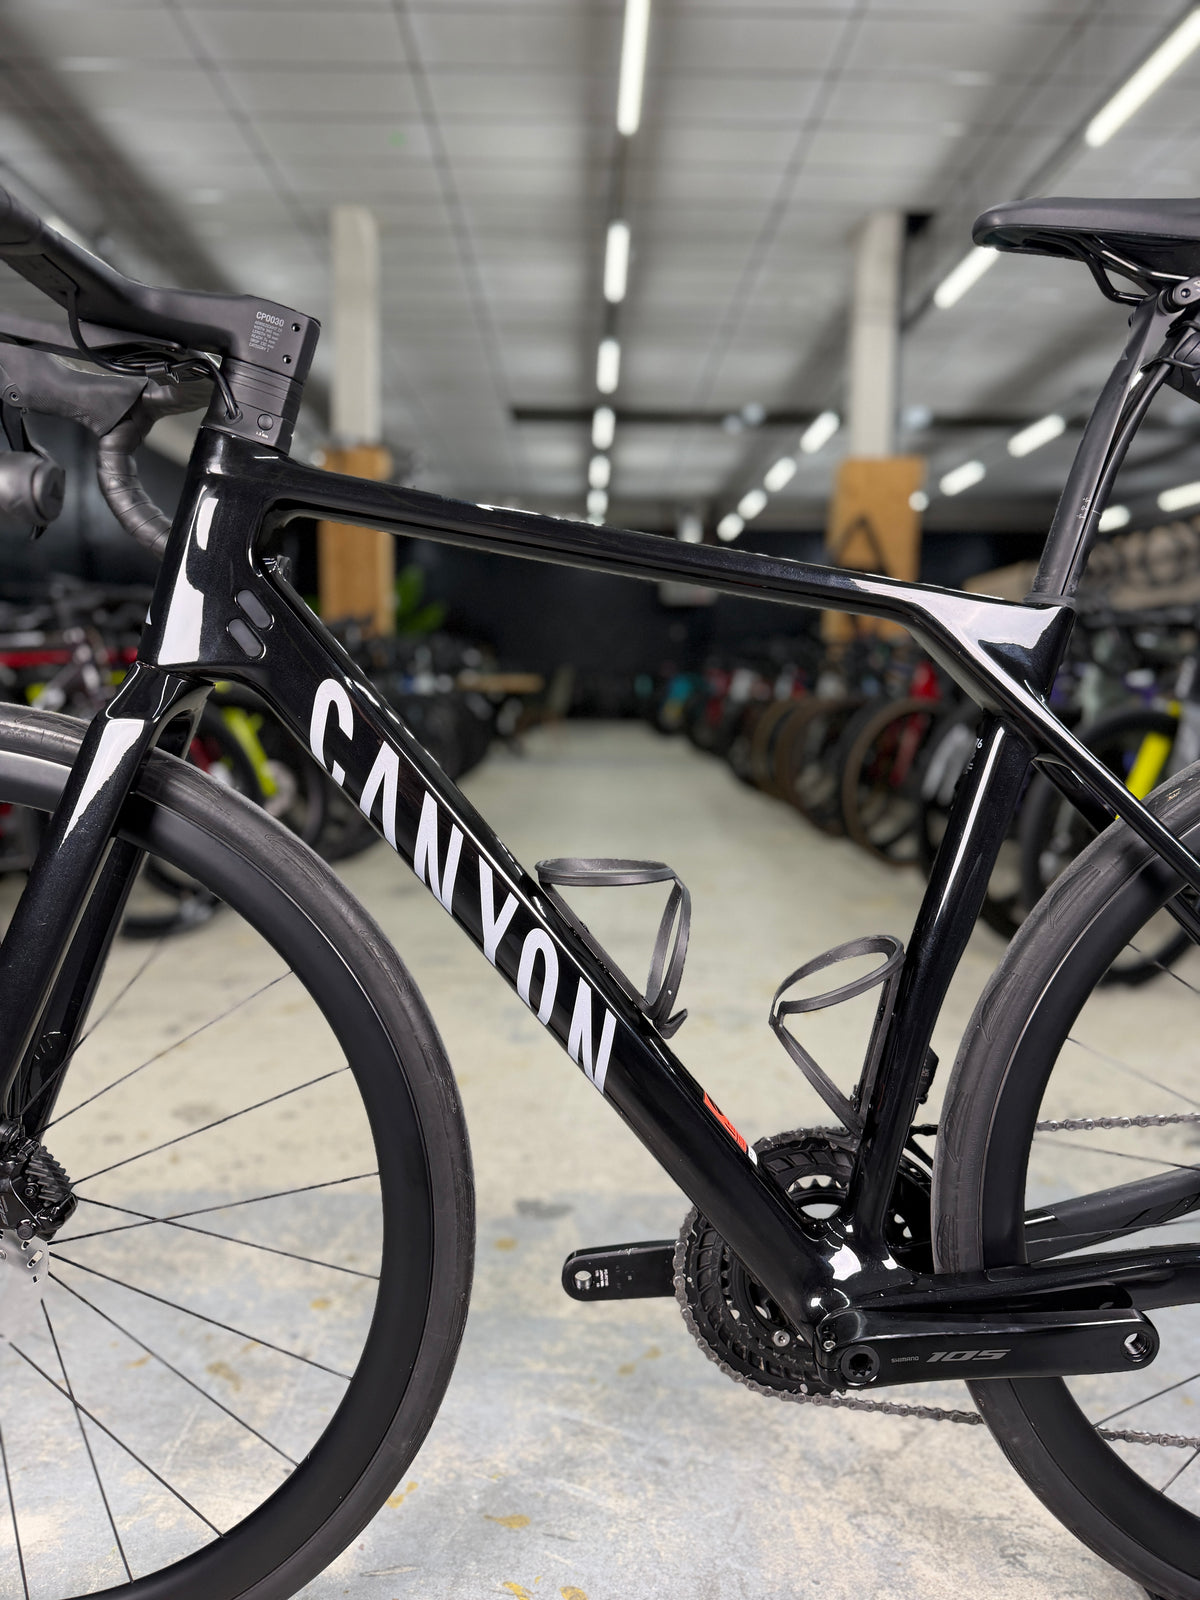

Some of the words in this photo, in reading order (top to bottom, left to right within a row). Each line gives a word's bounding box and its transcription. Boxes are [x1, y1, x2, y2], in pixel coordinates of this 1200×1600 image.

[256, 311, 285, 327] CP0030
[309, 678, 617, 1095] CANYON
[926, 1348, 1012, 1363] 105
